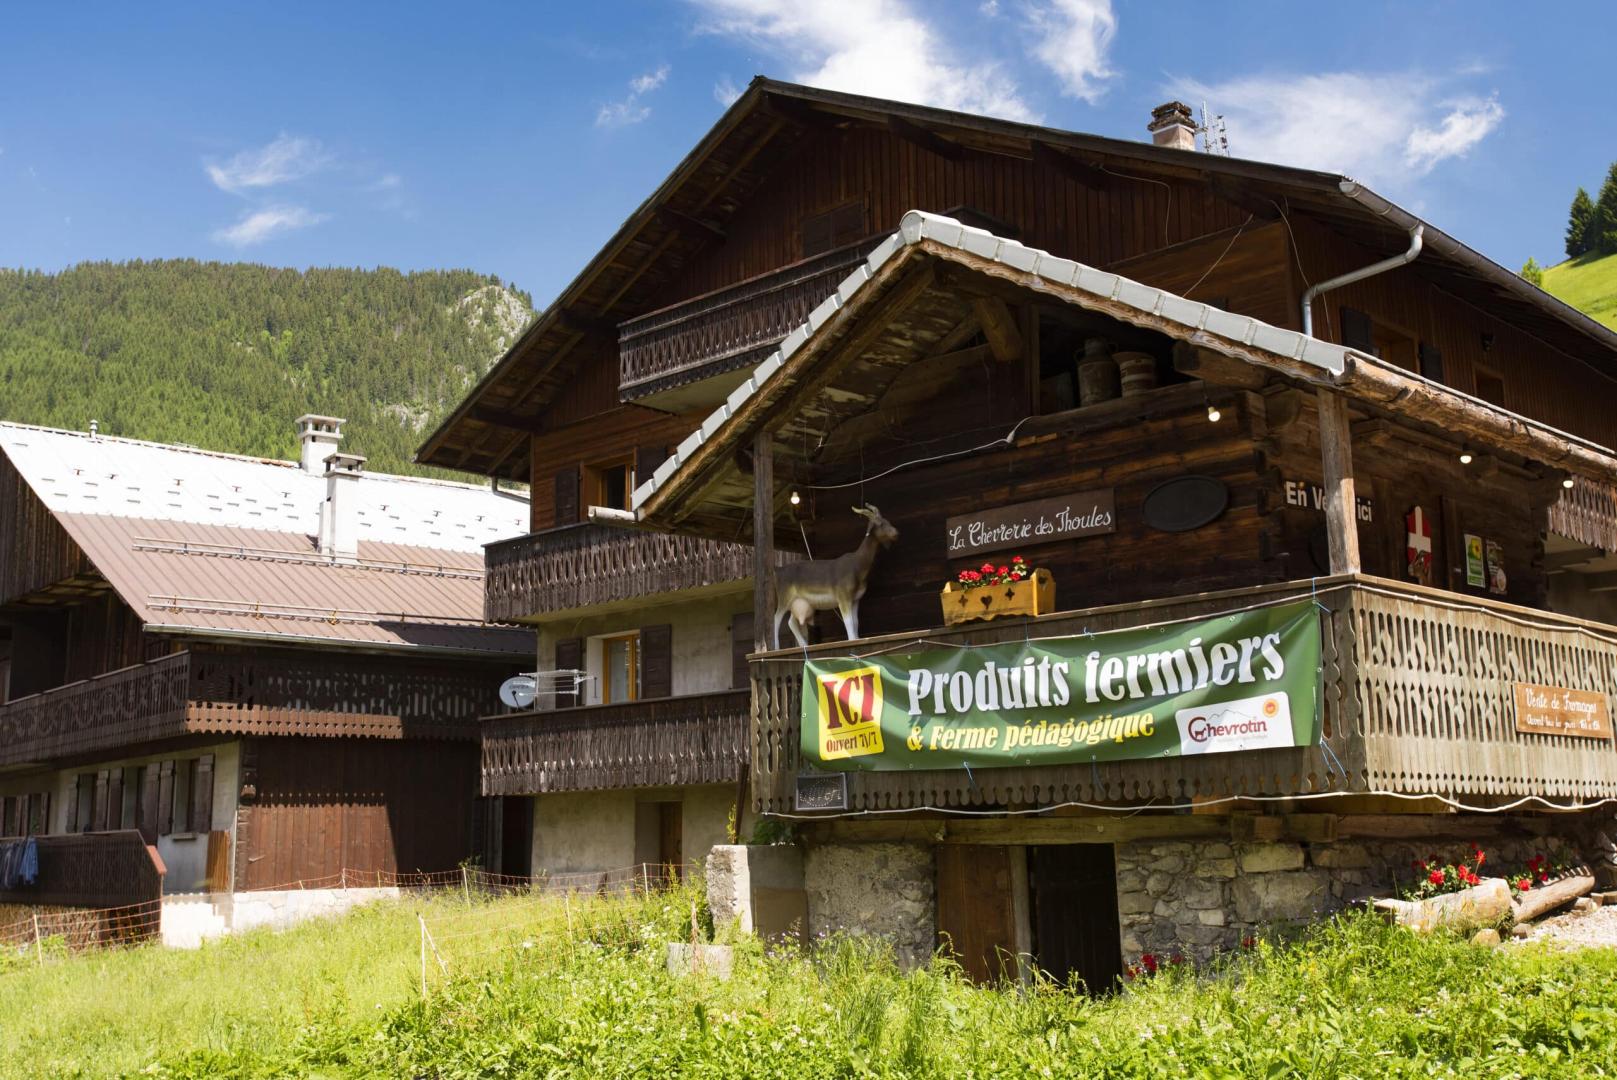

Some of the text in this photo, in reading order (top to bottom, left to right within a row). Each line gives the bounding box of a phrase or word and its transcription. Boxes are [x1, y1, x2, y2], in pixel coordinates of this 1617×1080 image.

[1286, 481, 1307, 507] En
[1357, 498, 1372, 522] ici
[949, 526, 965, 550] La
[1035, 516, 1053, 535] des
[1056, 506, 1111, 532] Thoules
[908, 632, 1284, 715] Produits fermiers
[822, 673, 874, 729] ICI
[1551, 693, 1560, 709] de
[826, 736, 858, 752] Ouvert
[907, 712, 1155, 751] & Ferme pédagogique
[1188, 716, 1267, 742] Chevrotin
